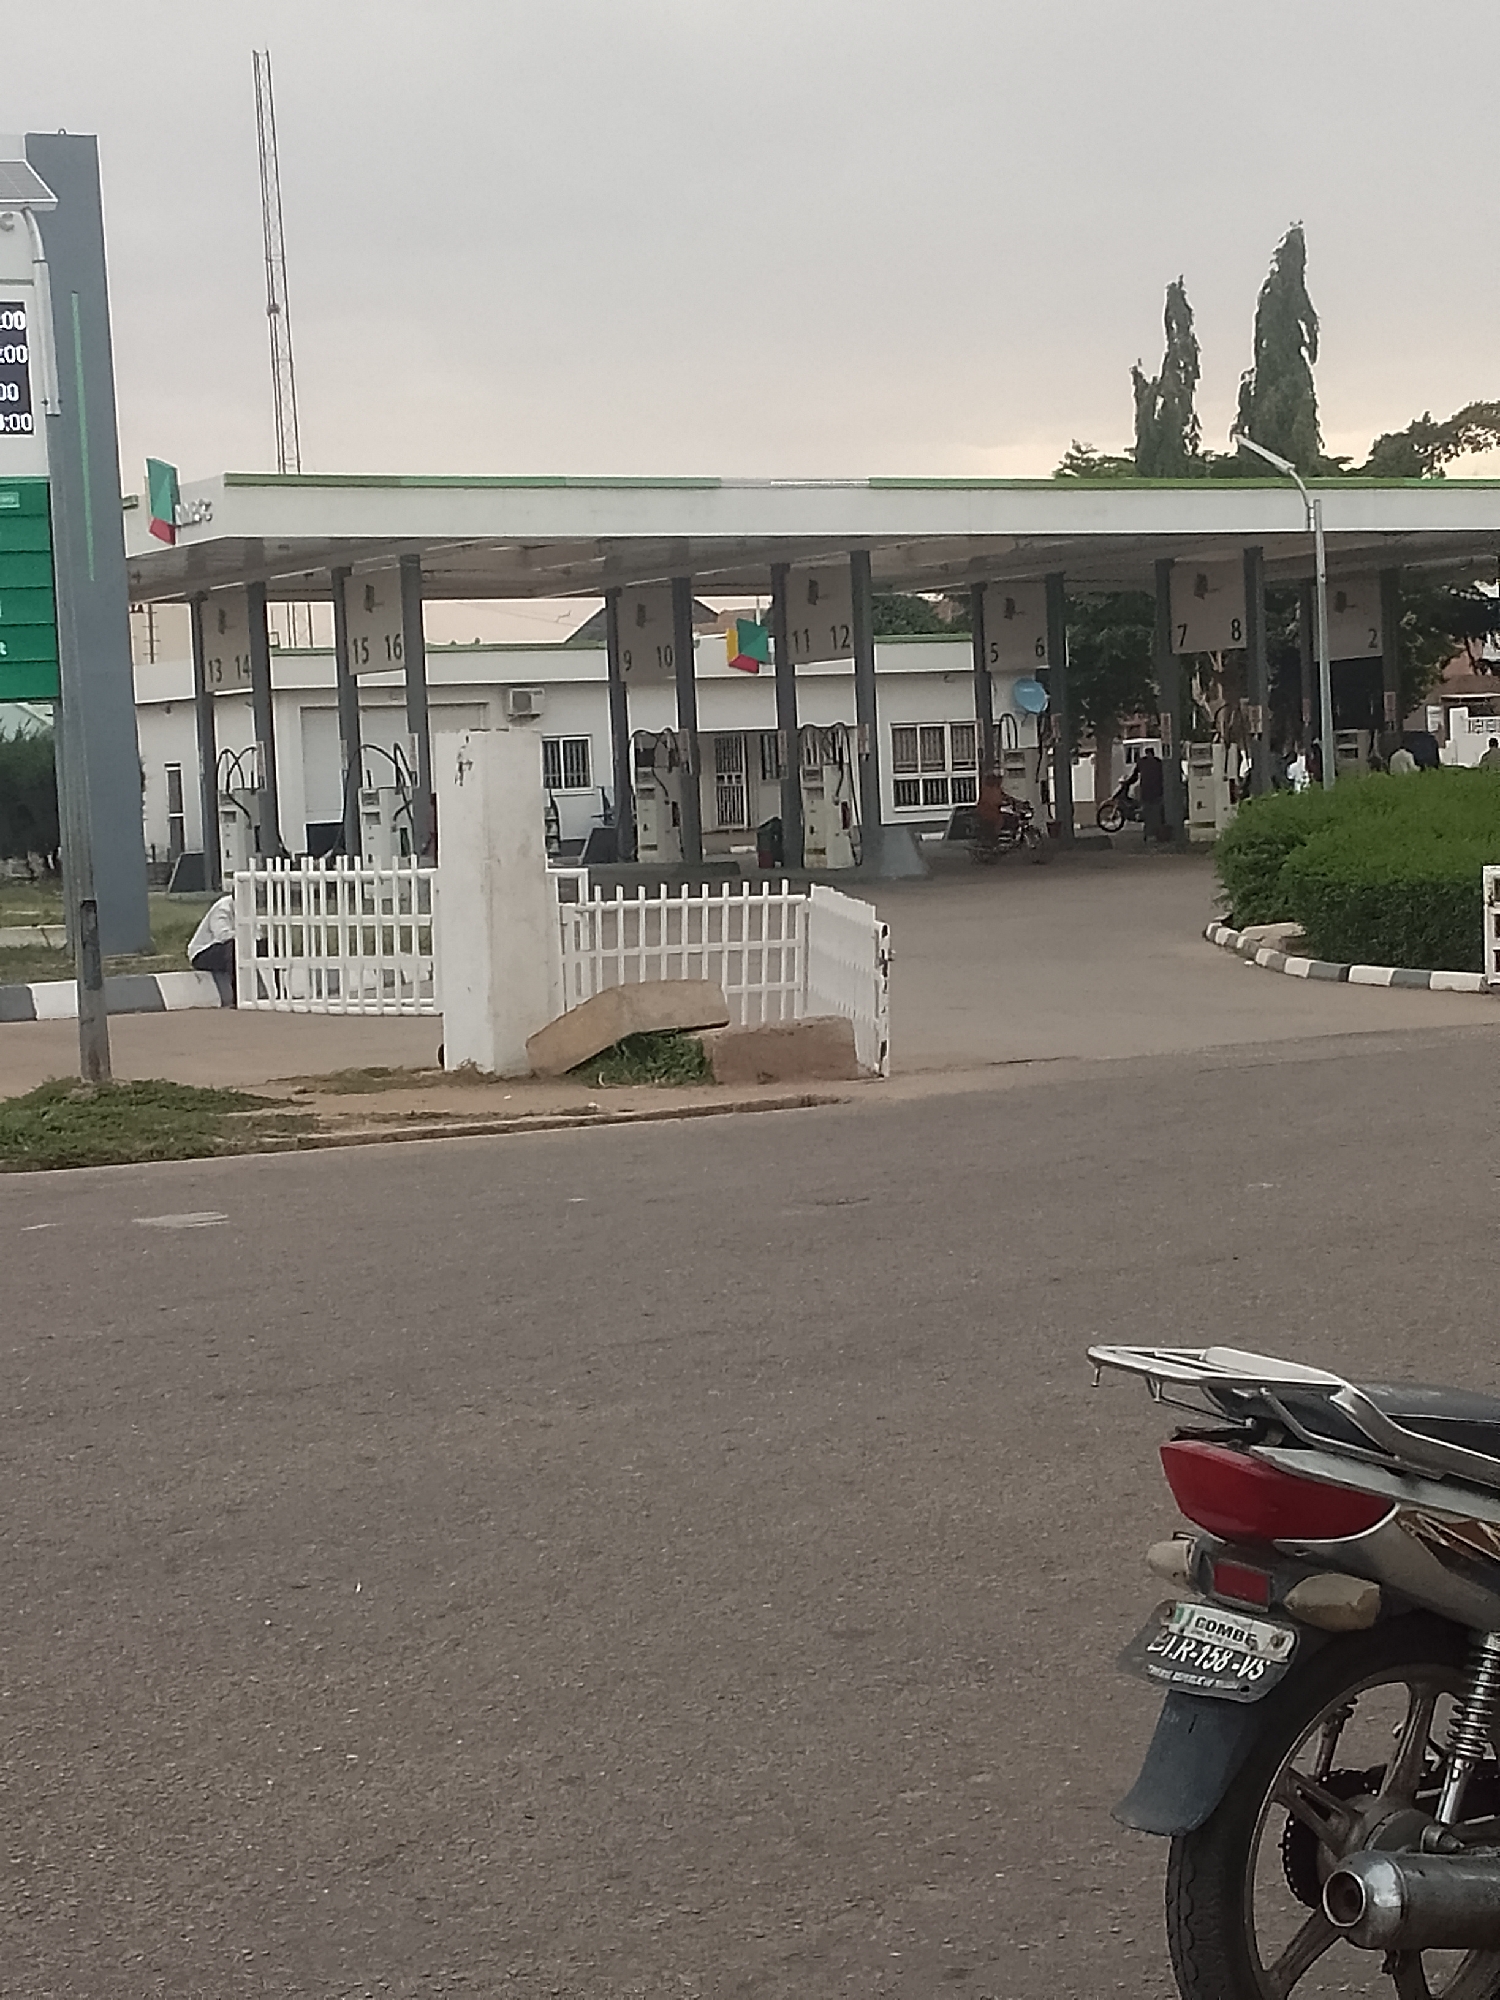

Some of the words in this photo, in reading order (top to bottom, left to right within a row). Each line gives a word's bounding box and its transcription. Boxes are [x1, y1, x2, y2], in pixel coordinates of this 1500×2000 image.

[792, 628, 810, 654] 11
[830, 624, 851, 651] 12
[1177, 623, 1188, 647] 7
[1231, 618, 1242, 642] 8
[1367, 628, 1378, 649] 2
[353, 636, 370, 665] 15
[385, 633, 402, 661] 16
[623, 649, 632, 672] 9
[657, 645, 673, 668] 10
[990, 642, 999, 664] 5
[1035, 637, 1045, 658] 6
[208, 657, 223, 684] 13
[235, 654, 250, 680] 14
